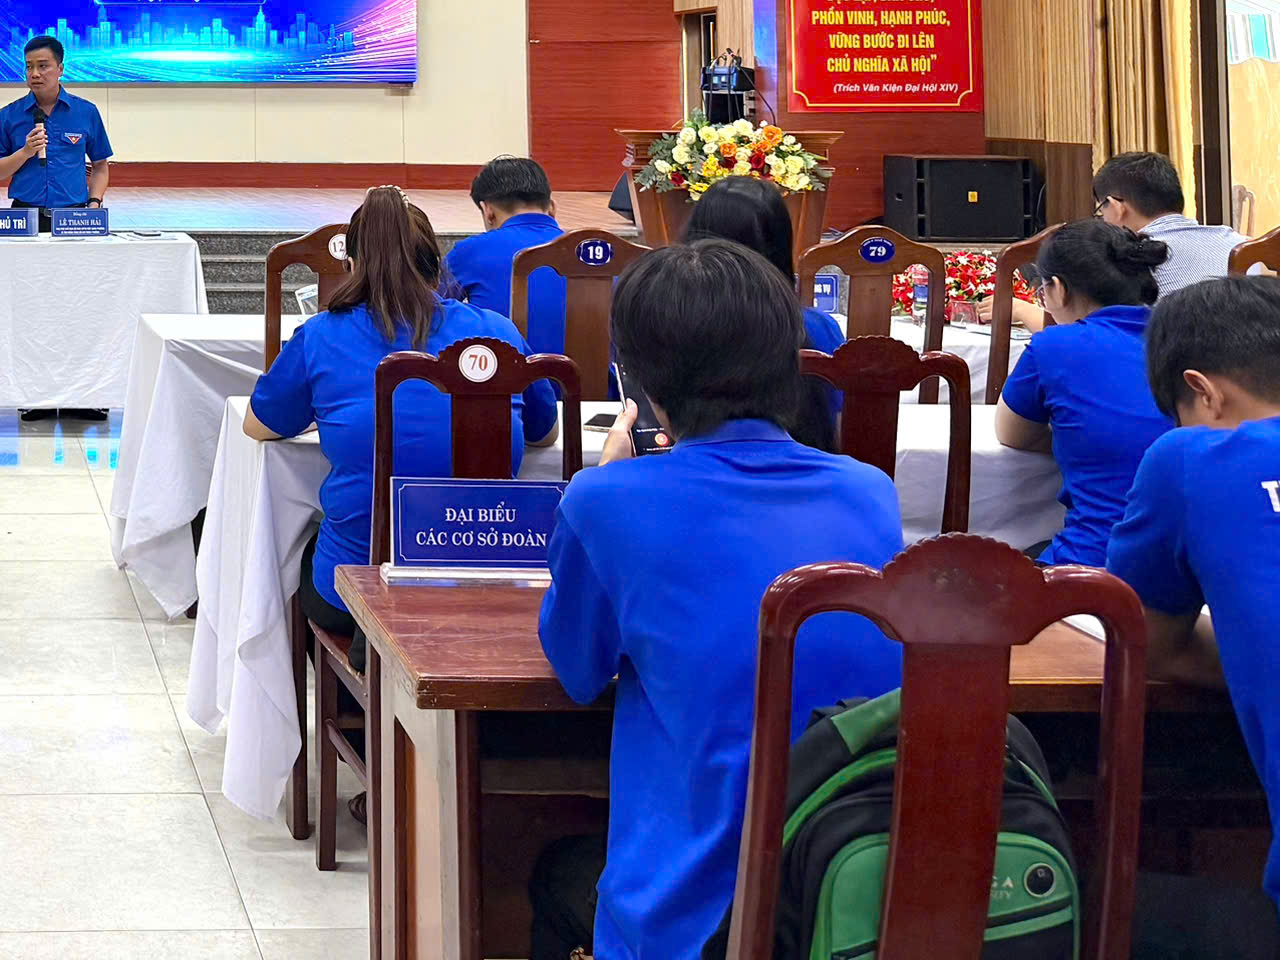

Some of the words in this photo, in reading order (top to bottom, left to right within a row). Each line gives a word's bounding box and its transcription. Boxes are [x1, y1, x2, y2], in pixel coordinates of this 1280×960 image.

[829, 32, 860, 48] VỮNG
[864, 32, 894, 48] BƯỚC
[898, 35, 909, 48] ĐI
[913, 32, 934, 48] LÊN
[13, 217, 26, 229] TRÌ
[333, 241, 346, 252] 12
[588, 245, 604, 260] 19
[869, 246, 887, 257] 79
[469, 354, 489, 371] 70
[445, 508, 474, 525] ĐẠI
[478, 501, 516, 522] BIỂU
[416, 528, 448, 546] CÁC
[452, 530, 474, 546] CƠ
[477, 527, 498, 547] SỞ
[502, 528, 547, 547] ĐOÀN
